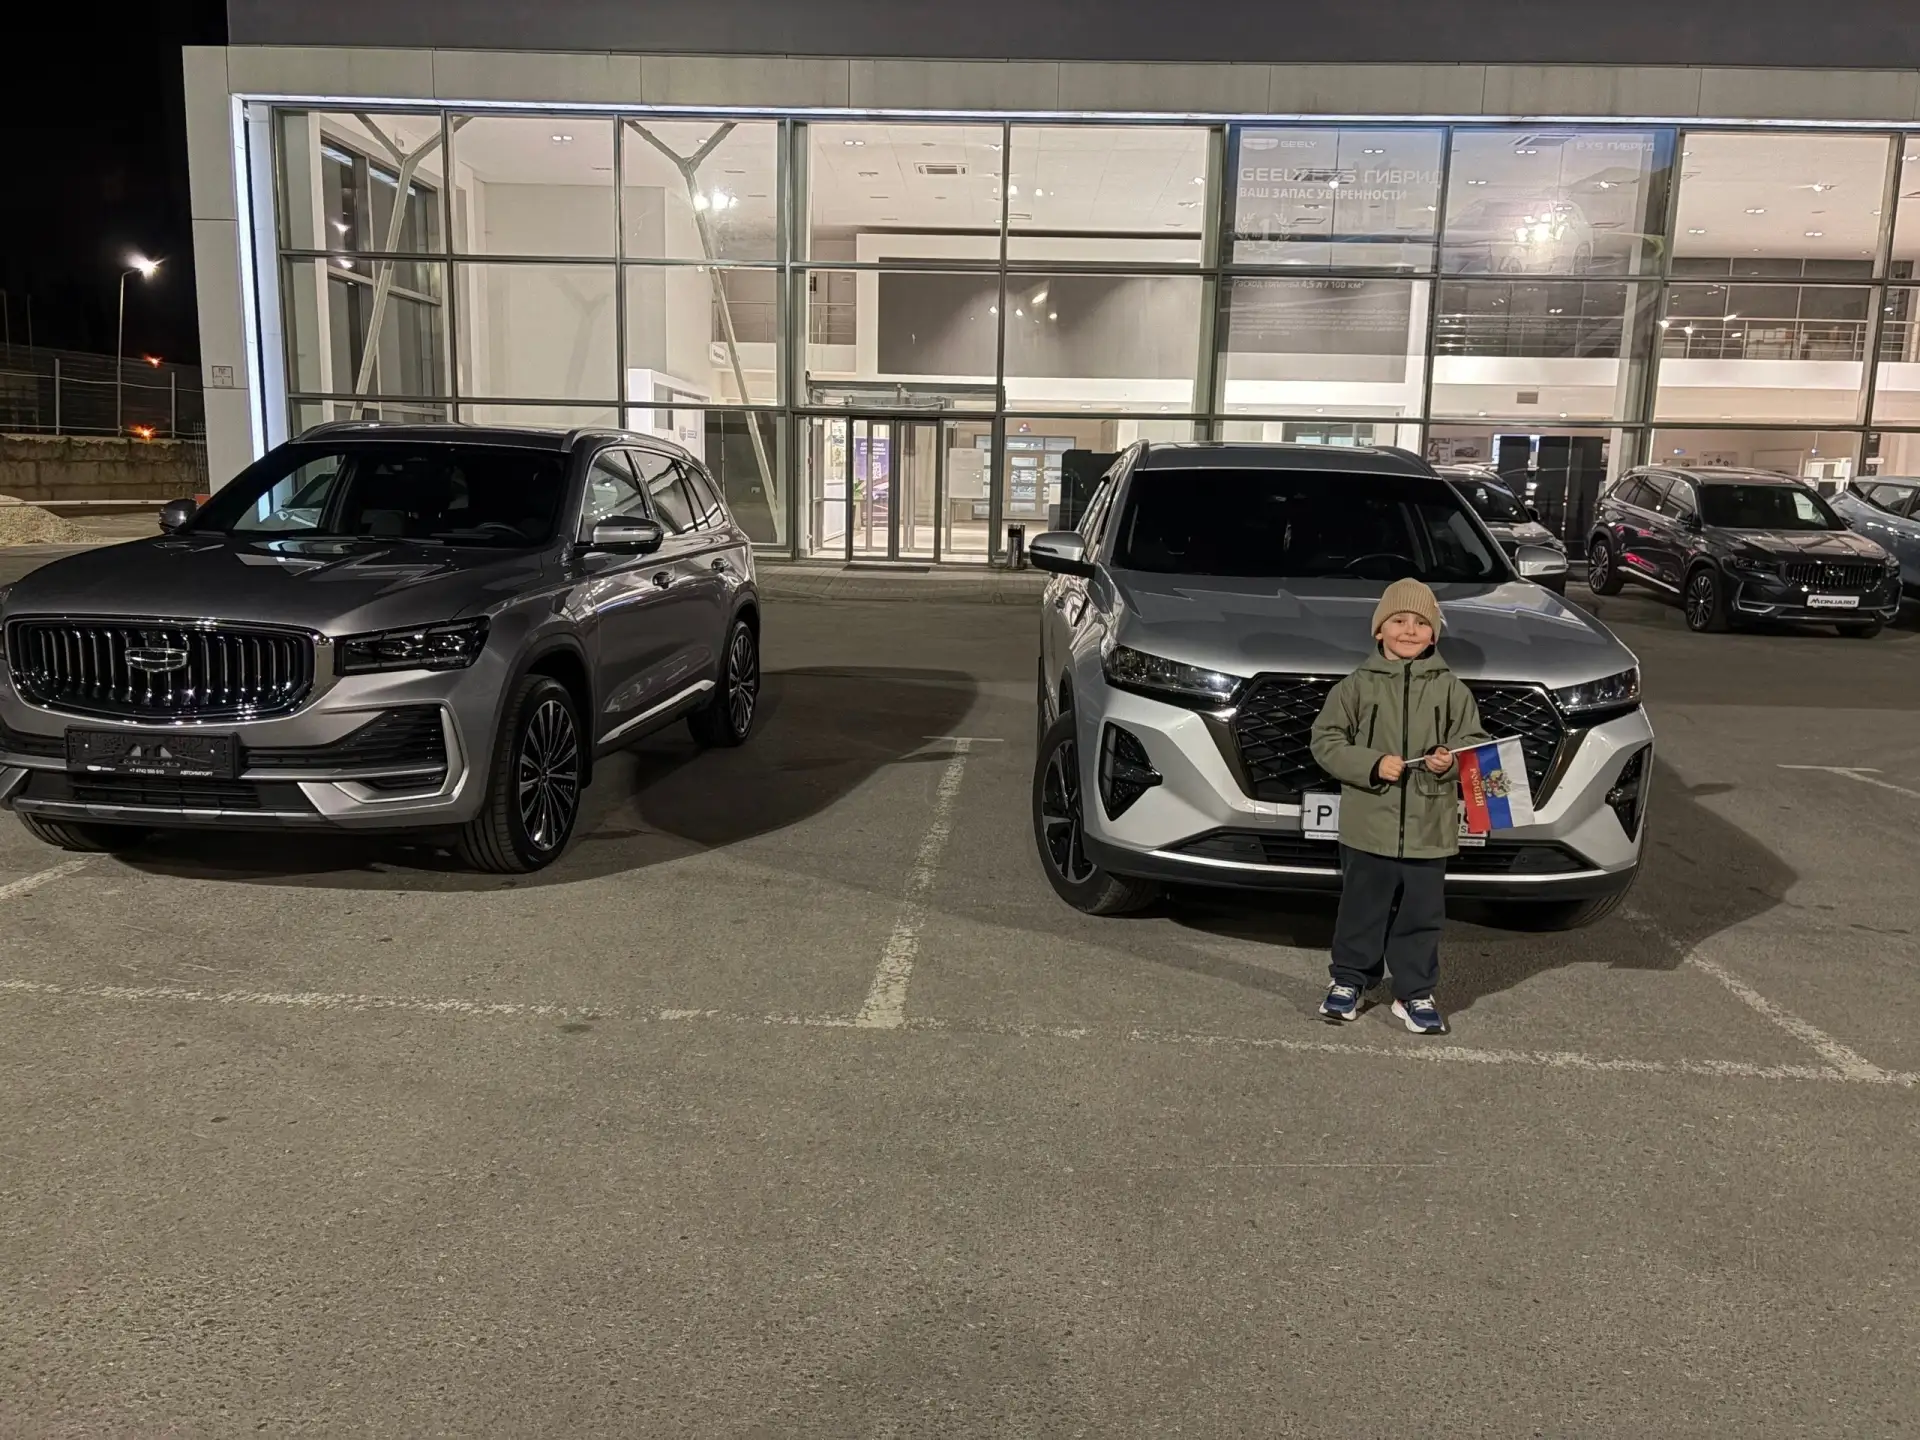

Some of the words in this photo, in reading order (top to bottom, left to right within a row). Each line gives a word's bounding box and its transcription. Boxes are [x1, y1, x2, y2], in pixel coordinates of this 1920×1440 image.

[1280, 140, 1317, 148] GEELY
[1608, 141, 1655, 152] ГИБРИД
[1240, 187, 1269, 197] ВАШ
[1271, 188, 1314, 199] ЗАПАС
[1316, 188, 1408, 200] УВЕРЕННОСТИ
[1331, 281, 1346, 289] 100
[1810, 598, 1856, 606] MONJARO
[1469, 767, 1485, 807] РОССИЯ
